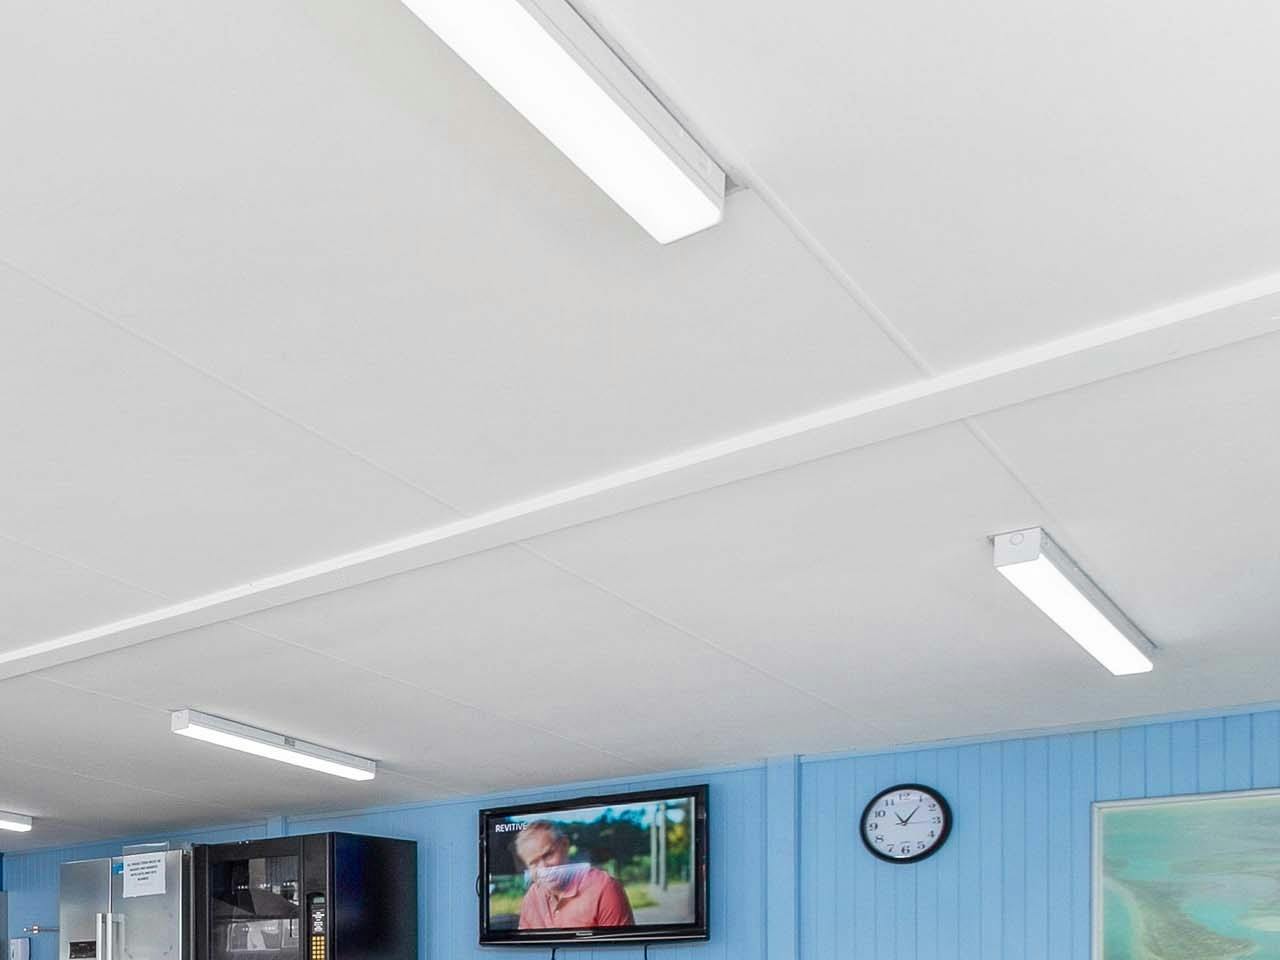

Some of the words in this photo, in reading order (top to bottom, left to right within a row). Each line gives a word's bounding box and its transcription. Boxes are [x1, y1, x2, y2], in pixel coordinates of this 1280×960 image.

[885, 799, 895, 807] 11
[928, 802, 937, 812] 2
[874, 810, 886, 818] 10
[932, 816, 941, 824] 3
[495, 823, 527, 832] REVITIVE
[869, 823, 879, 831] 9
[928, 830, 935, 838] 4
[875, 835, 884, 843] 8
[887, 844, 895, 853] 7
[917, 841, 926, 849] 5
[901, 845, 910, 854] 6
